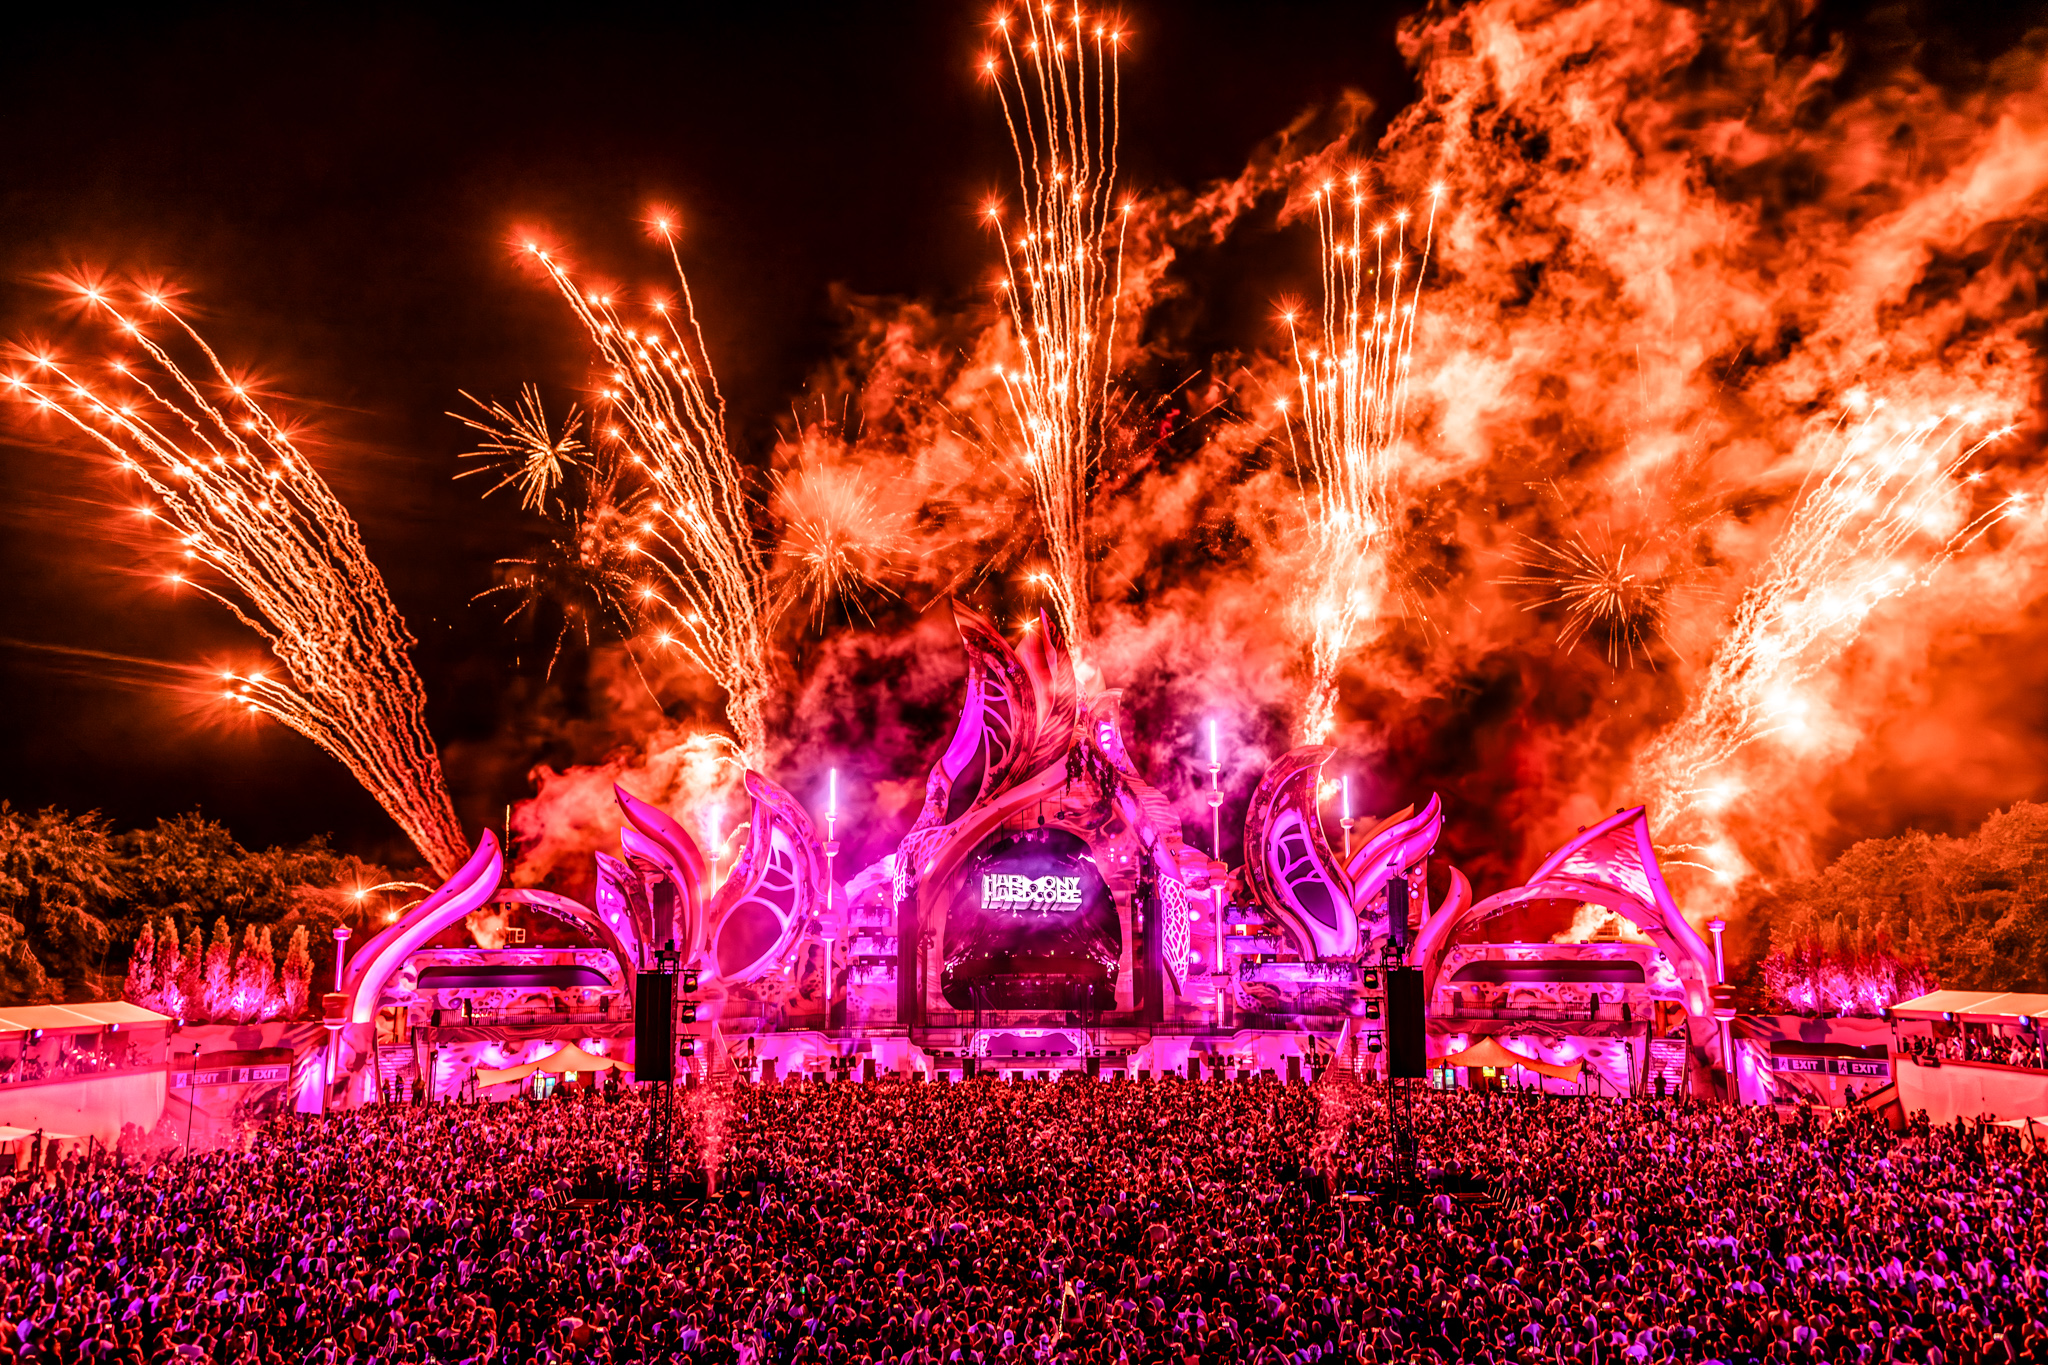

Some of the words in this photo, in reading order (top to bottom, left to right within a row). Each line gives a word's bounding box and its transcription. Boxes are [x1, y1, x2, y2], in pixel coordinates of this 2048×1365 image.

[982, 888, 1082, 905] HARDCORE
[1792, 1060, 1818, 1070] EXIT
[1852, 1063, 1878, 1075] EXIT
[193, 1073, 219, 1084] EXIT
[252, 1069, 279, 1080] EXIT
